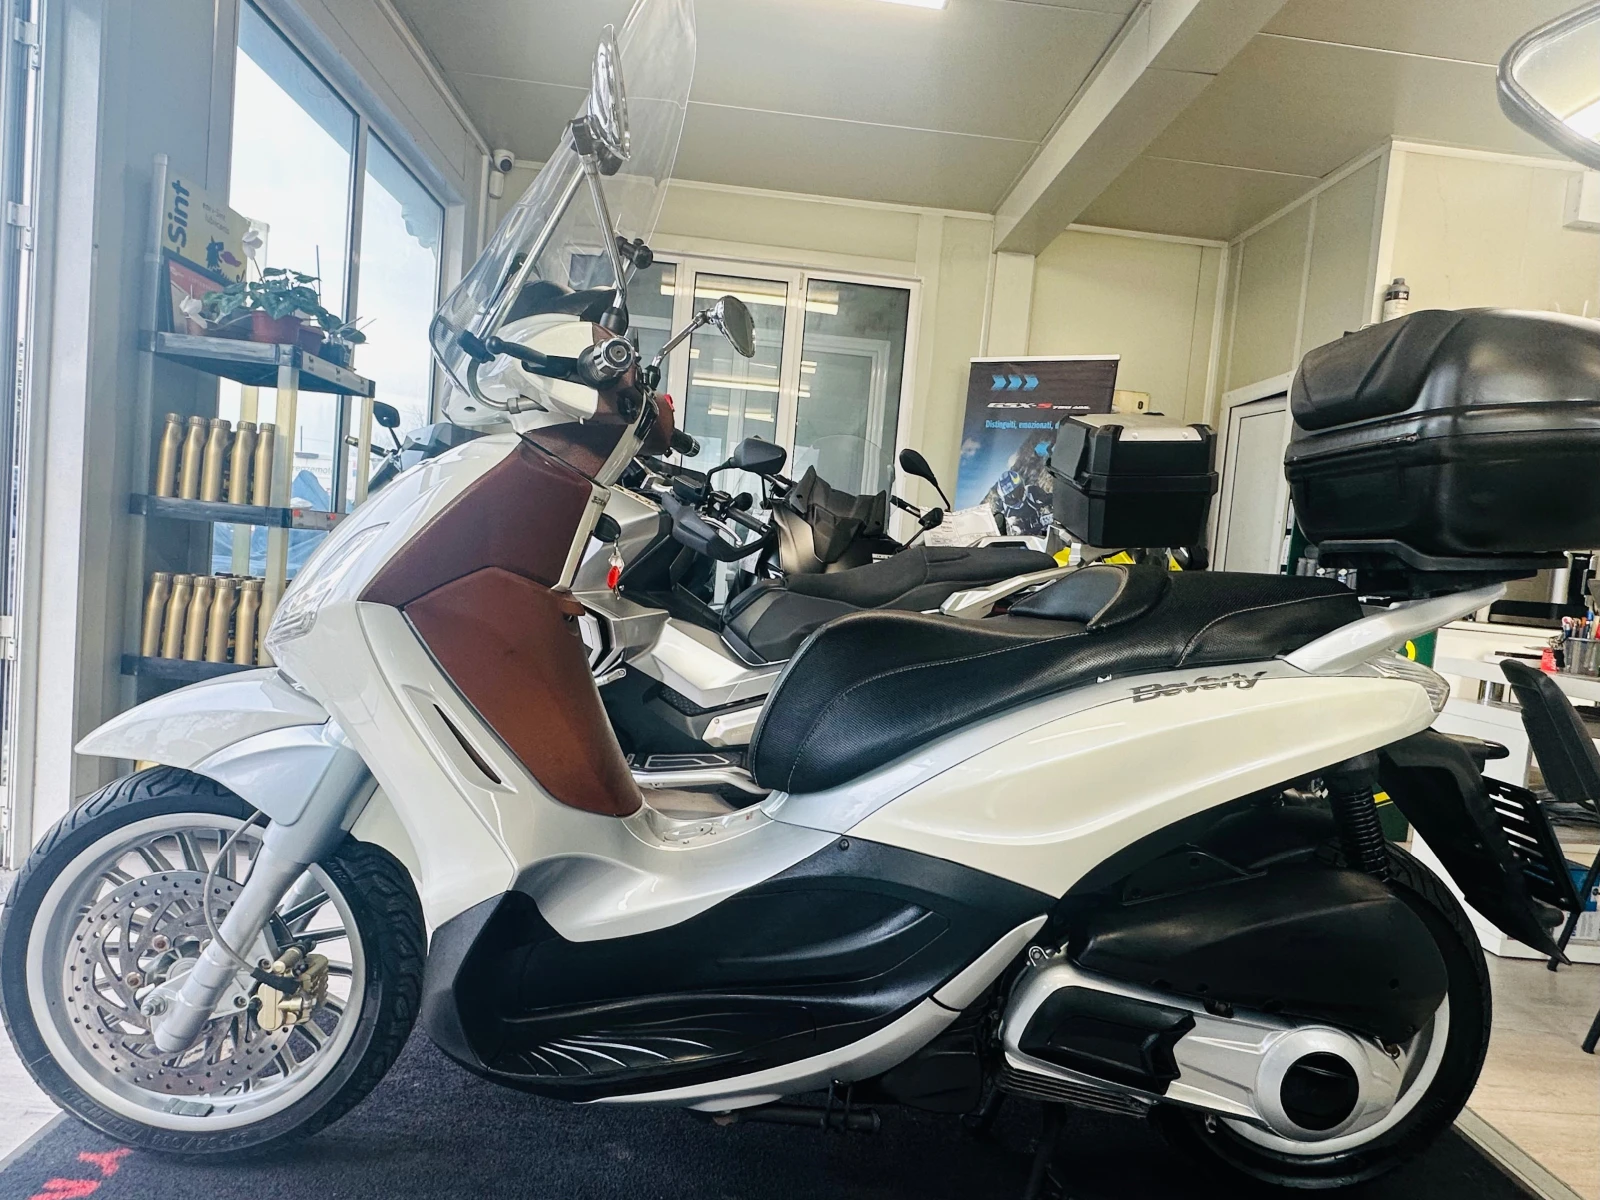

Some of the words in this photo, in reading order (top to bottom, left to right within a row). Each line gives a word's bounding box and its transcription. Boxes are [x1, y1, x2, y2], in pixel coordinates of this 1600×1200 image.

[167, 180, 190, 255] -Sint
[985, 419, 1017, 430] Distinguiti,
[1018, 420, 1053, 430] emozionati,
[1128, 670, 1268, 704] Beverly
